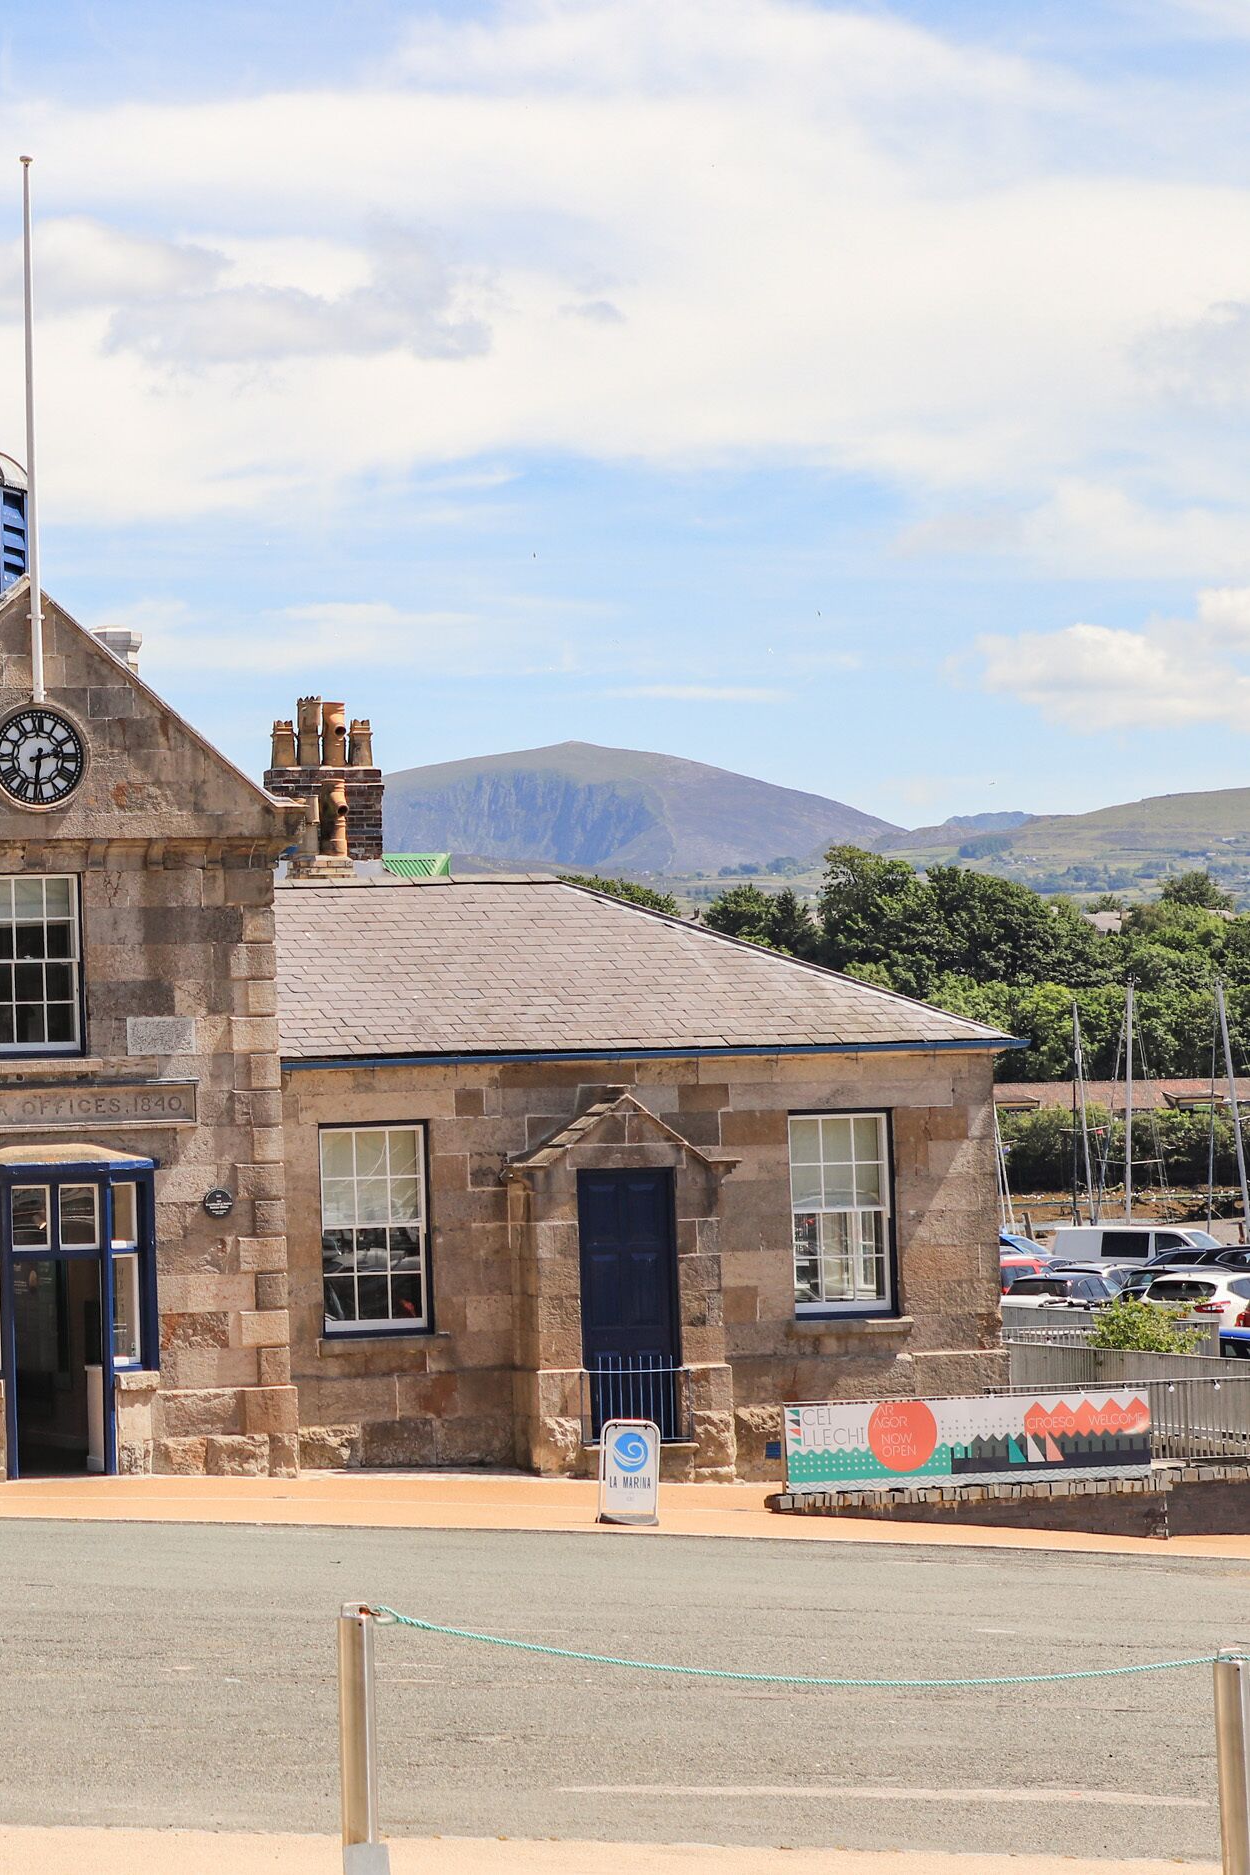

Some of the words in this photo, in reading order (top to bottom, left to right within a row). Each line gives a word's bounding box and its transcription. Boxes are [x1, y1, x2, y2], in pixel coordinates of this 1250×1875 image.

[802, 1407, 833, 1427] CEI
[876, 1405, 894, 1416] AR
[873, 1416, 908, 1429] AGOR
[1026, 1415, 1075, 1430] CROESO
[1087, 1412, 1144, 1426] WELCOME
[803, 1427, 866, 1447] LLECHI
[881, 1432, 913, 1445] NOW
[882, 1445, 917, 1458] OPEN
[609, 1476, 618, 1488] LA
[622, 1476, 651, 1489] MARINA
